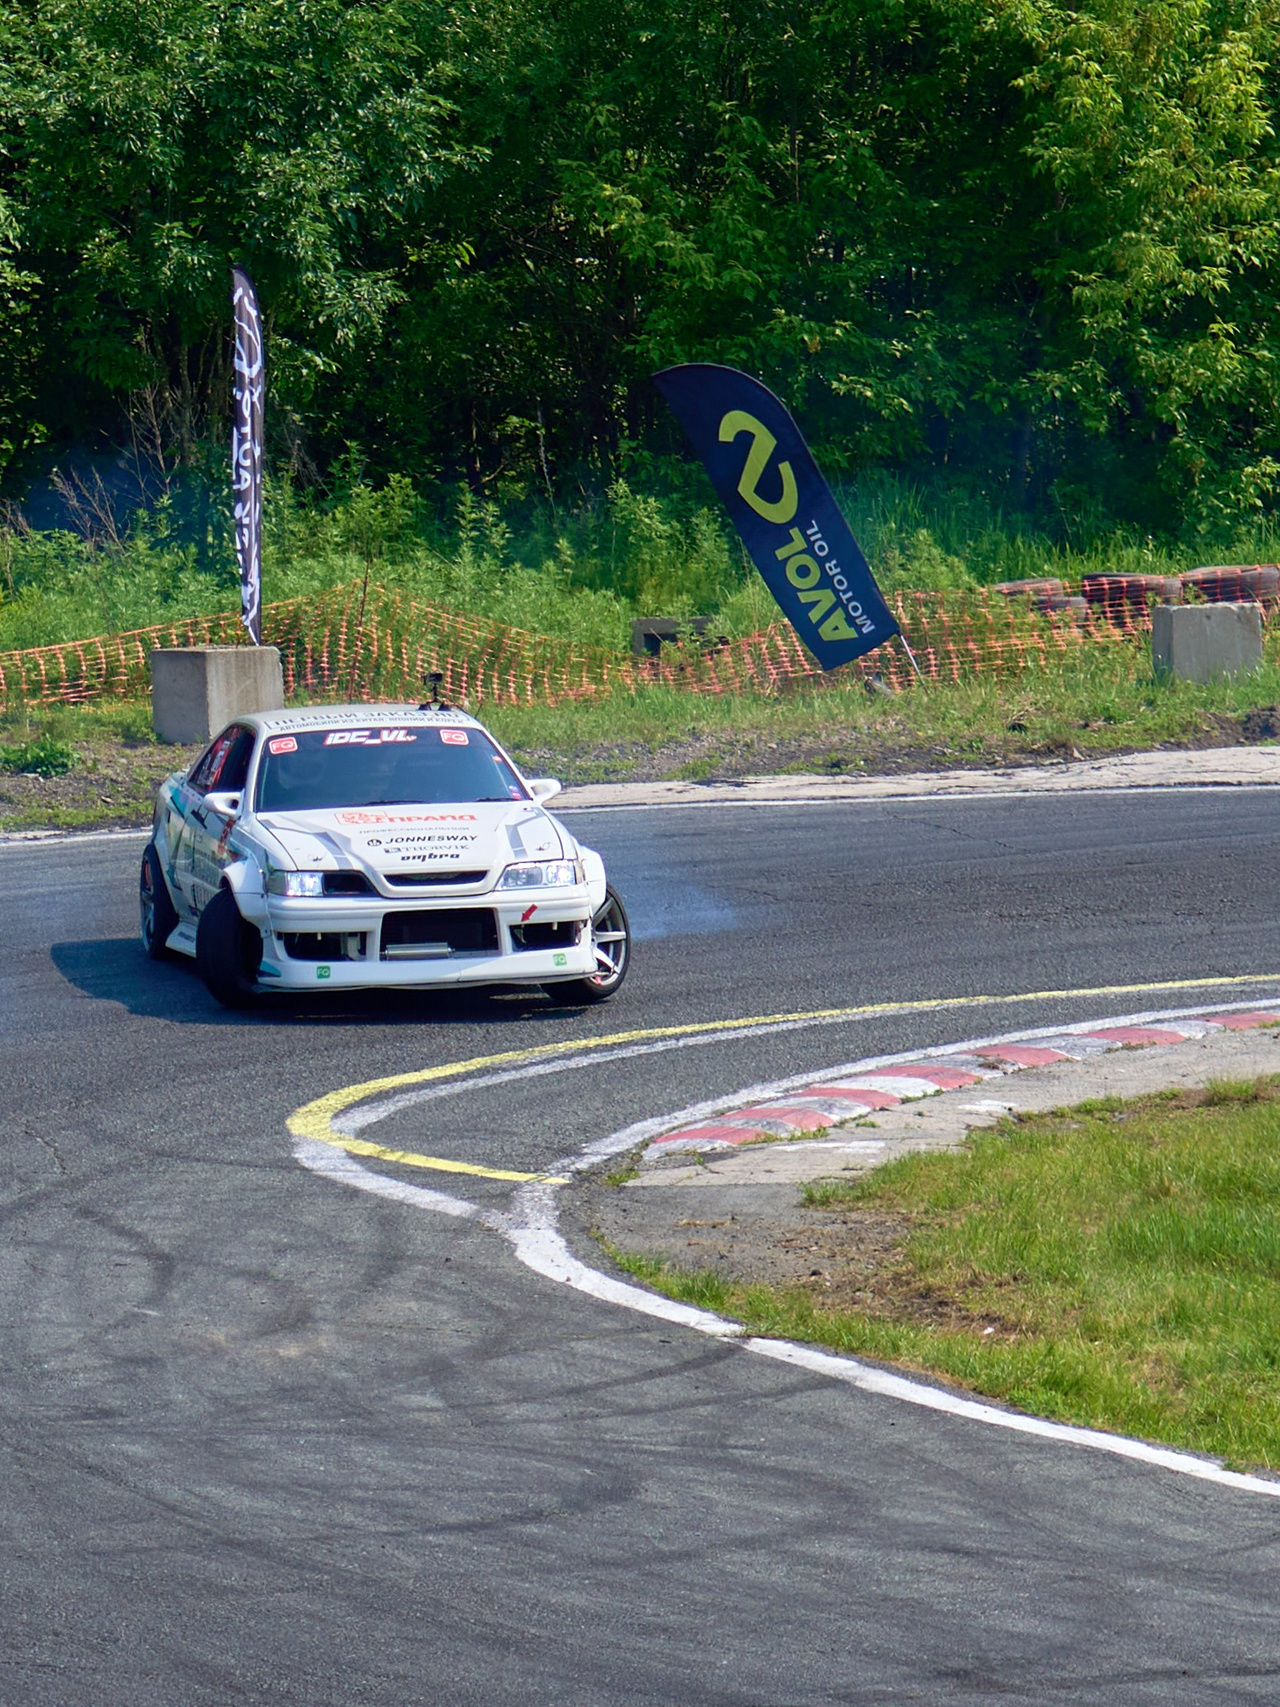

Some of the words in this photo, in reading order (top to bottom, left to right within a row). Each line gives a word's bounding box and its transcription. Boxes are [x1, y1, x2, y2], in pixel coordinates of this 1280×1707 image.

[805, 519, 829, 557] OIL
[775, 527, 859, 642] AVOL
[824, 558, 876, 634] MOTOR
[385, 835, 478, 844] JONNESWAY
